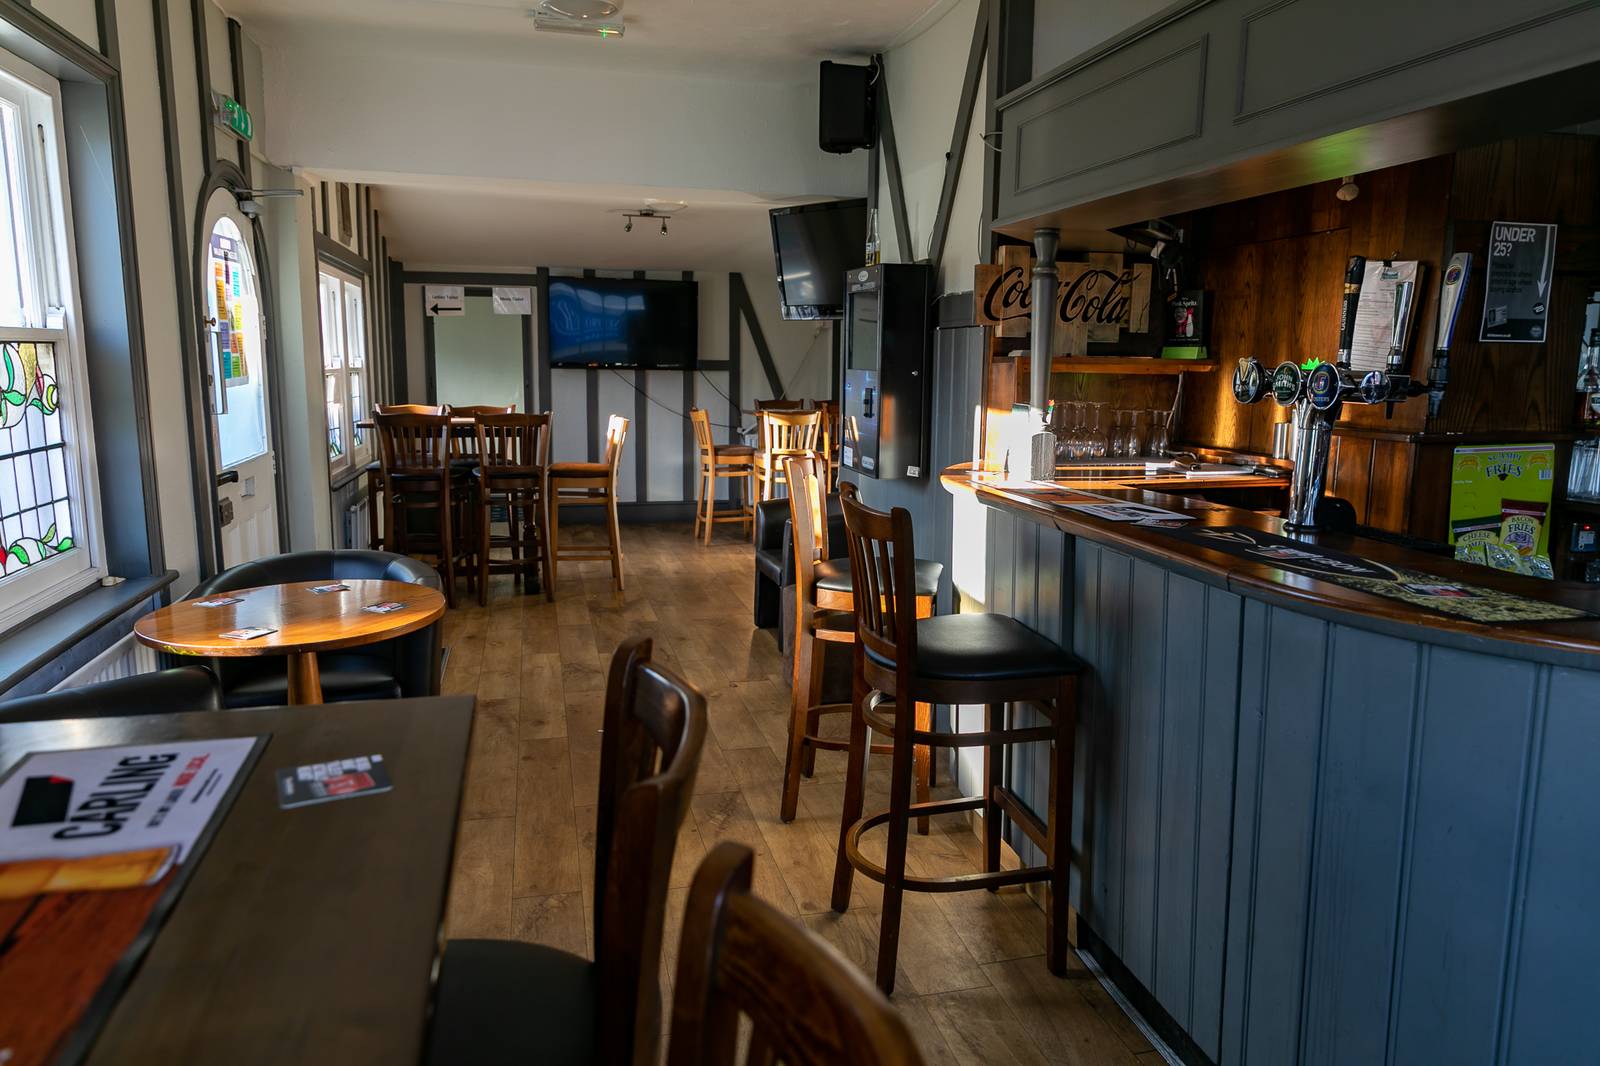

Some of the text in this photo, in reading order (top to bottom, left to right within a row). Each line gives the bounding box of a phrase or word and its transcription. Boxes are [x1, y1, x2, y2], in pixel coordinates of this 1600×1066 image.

[1495, 226, 1536, 243] UNDER
[1494, 242, 1513, 257] 25?
[983, 266, 1143, 324] Coc-Cola
[1275, 374, 1293, 383] JOHN
[1485, 463, 1523, 479] FRIES
[1511, 516, 1534, 524] BACON
[1462, 531, 1491, 542] CHEESE
[1508, 523, 1536, 535] FRIES
[52, 752, 179, 840] CARLING
